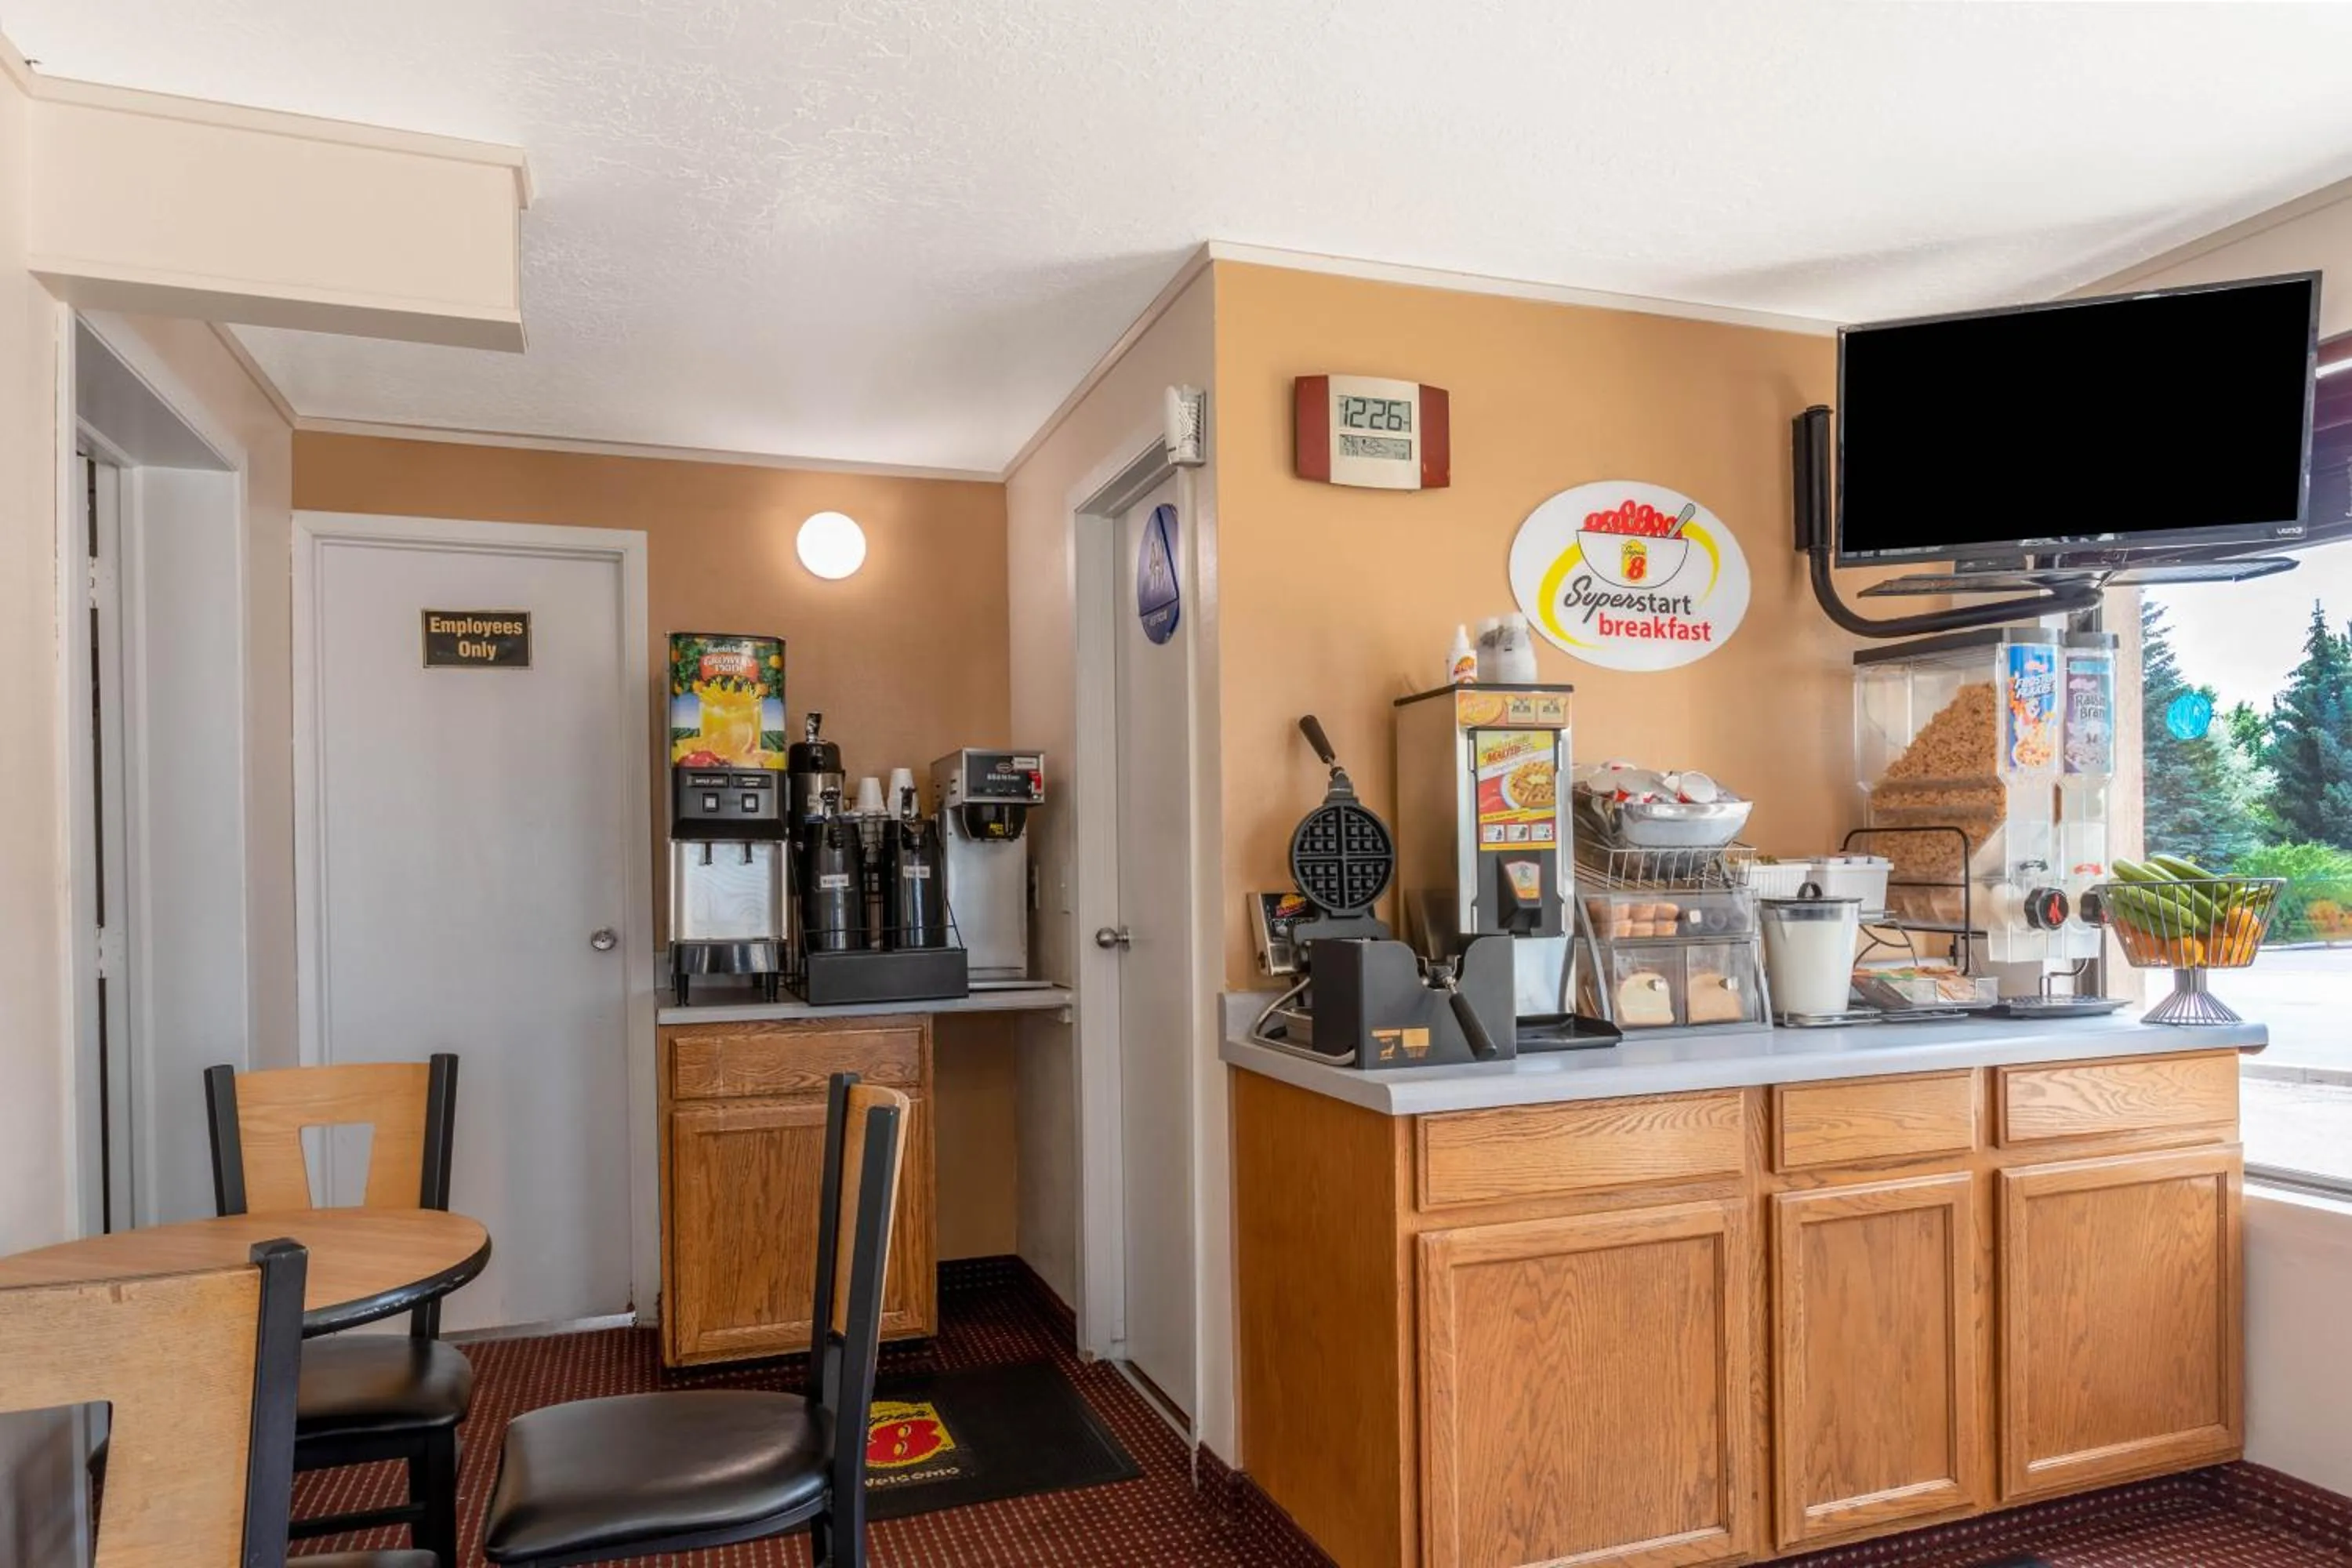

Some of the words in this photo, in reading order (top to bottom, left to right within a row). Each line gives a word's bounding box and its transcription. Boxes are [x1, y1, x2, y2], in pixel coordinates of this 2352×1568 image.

[1627, 555, 1646, 581] 8
[430, 616, 523, 637] Employees
[1599, 612, 1712, 642] breakfast
[458, 641, 497, 661] Only
[2075, 693, 2107, 707] Raisin
[2080, 706, 2106, 719] Bran
